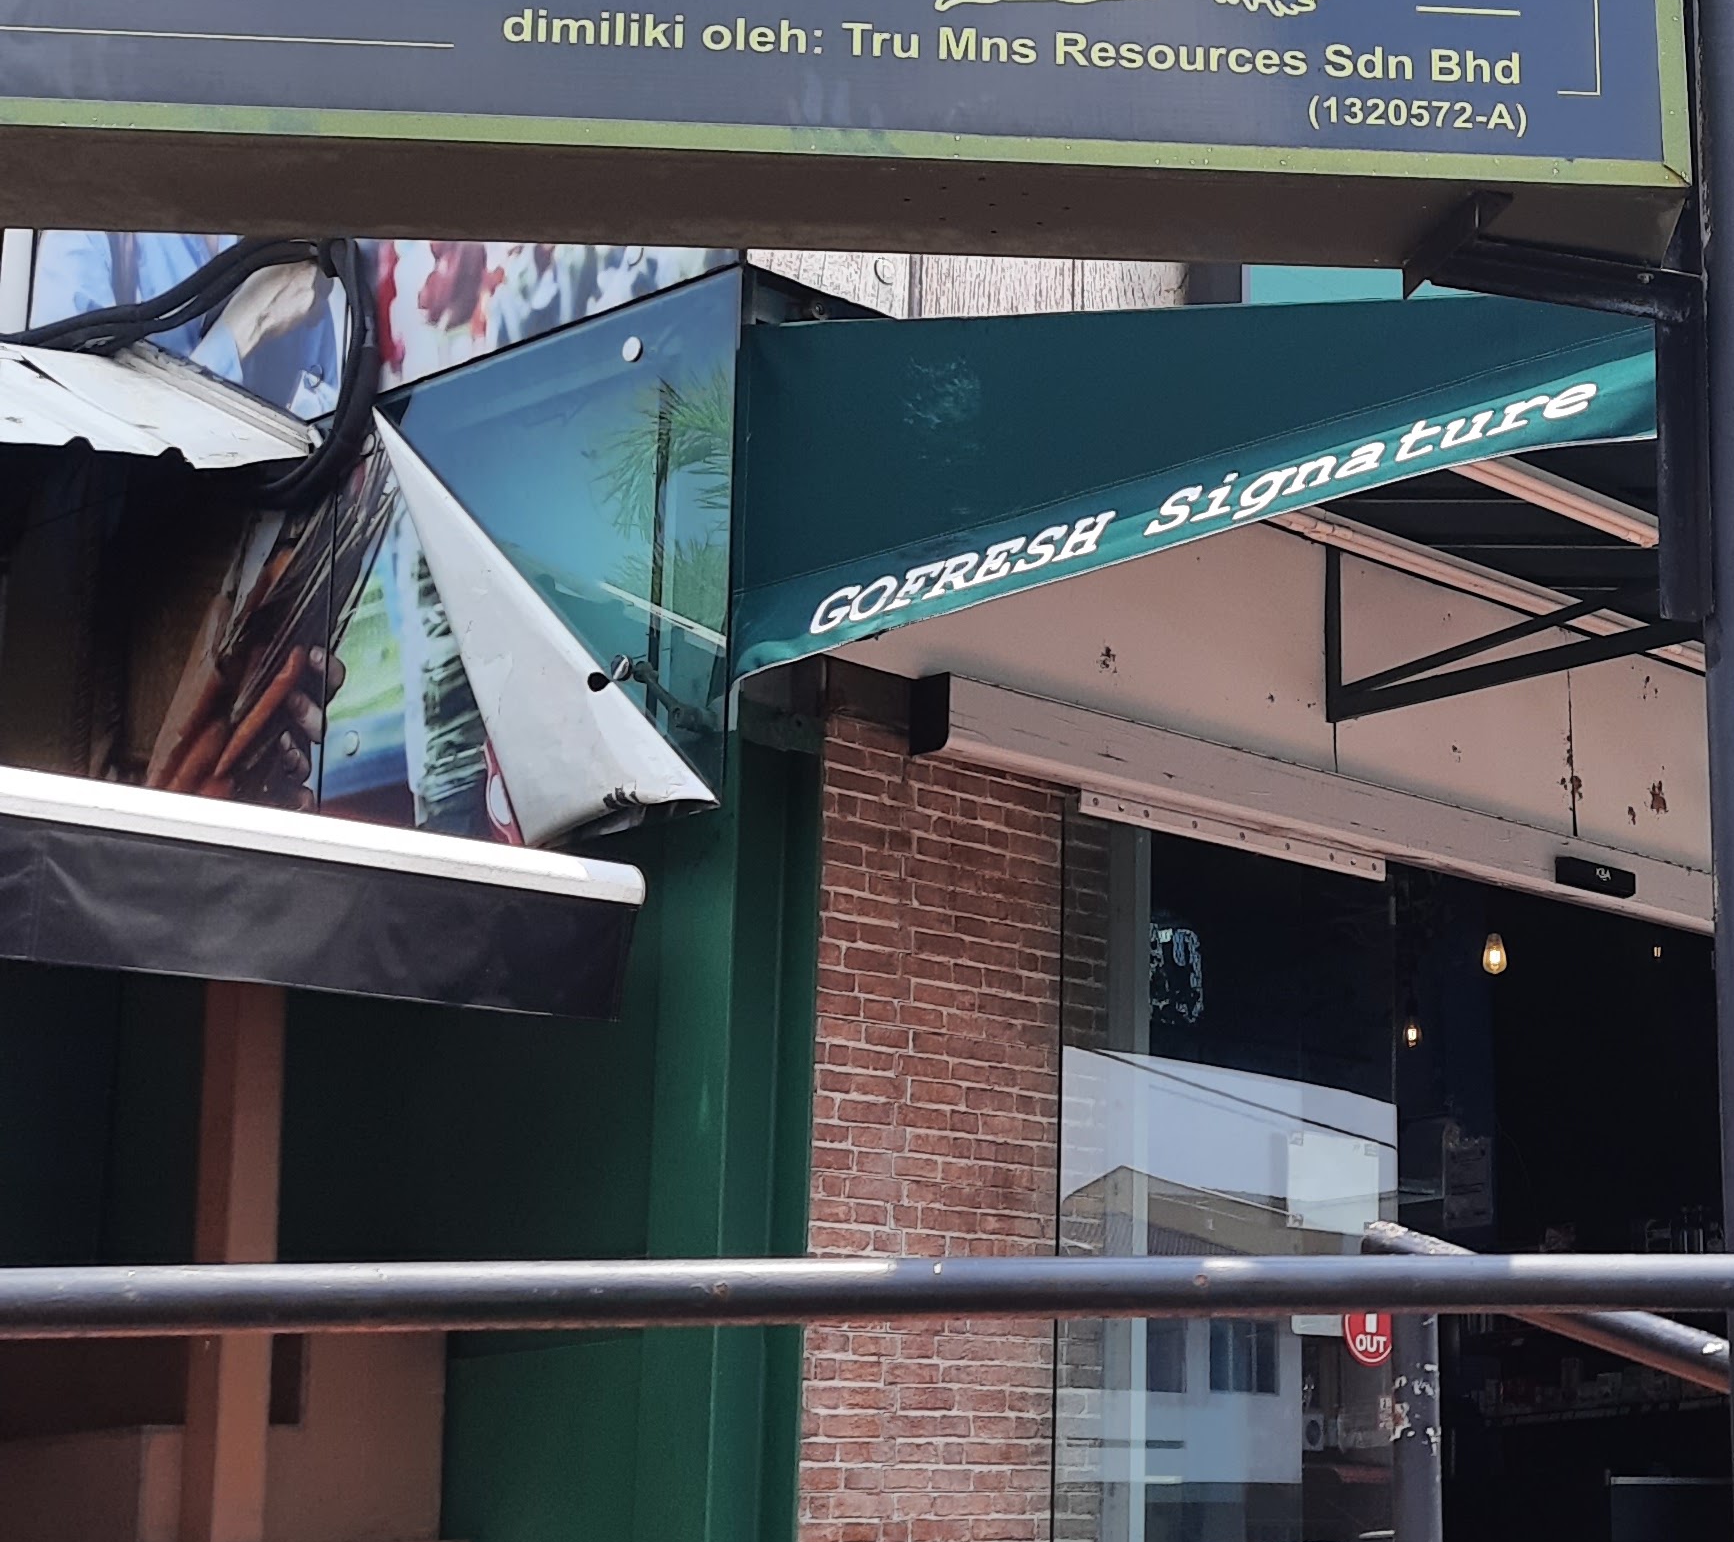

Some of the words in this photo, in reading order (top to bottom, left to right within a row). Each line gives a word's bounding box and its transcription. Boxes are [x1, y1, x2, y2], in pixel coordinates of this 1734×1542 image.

[502, 9, 685, 49] dimiliki
[702, 18, 823, 55] oleh:
[842, 22, 919, 59] Tru
[938, 26, 1037, 64] Mns
[1055, 31, 1308, 76] Resources
[1324, 44, 1414, 82] Sdn
[1430, 48, 1522, 86] Bhd
[1308, 94, 1528, 138] (1320572-A)
[809, 509, 1118, 635] GOFRESH
[1143, 381, 1598, 538] Signature
[1355, 1334, 1388, 1354] OUT
